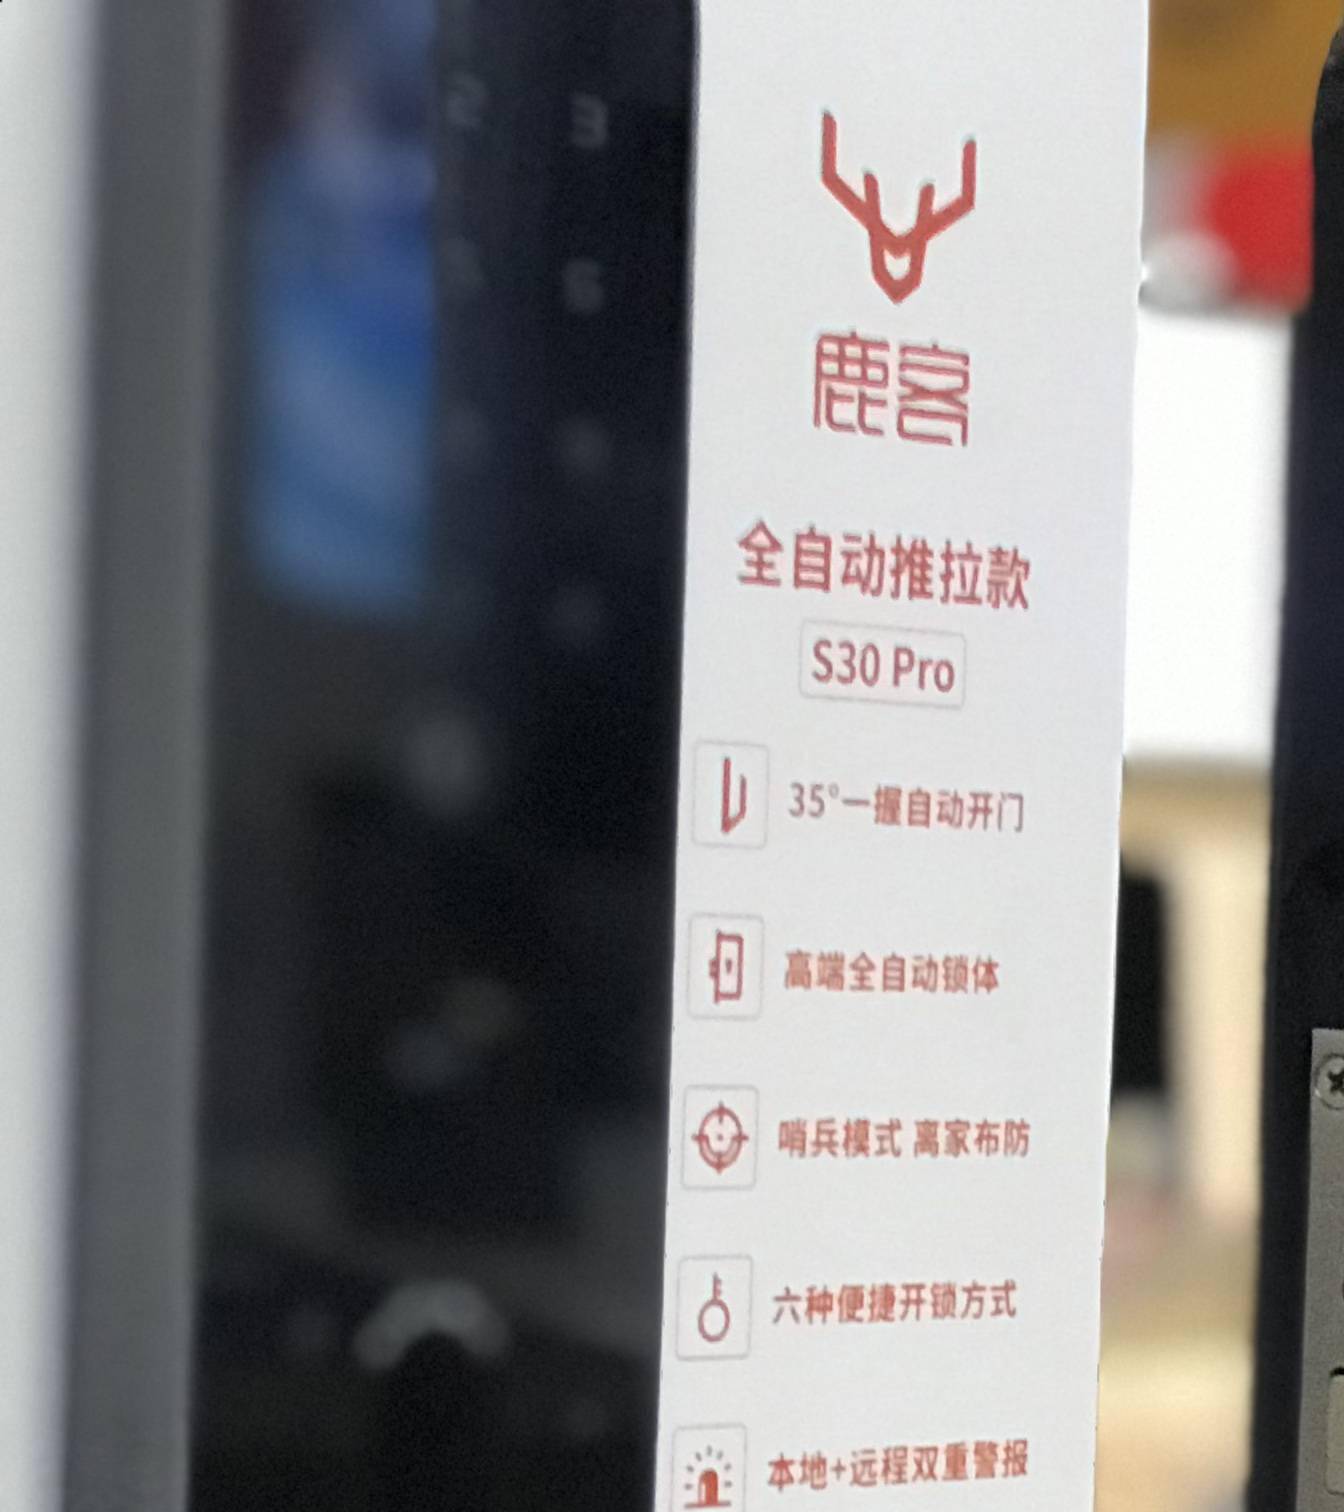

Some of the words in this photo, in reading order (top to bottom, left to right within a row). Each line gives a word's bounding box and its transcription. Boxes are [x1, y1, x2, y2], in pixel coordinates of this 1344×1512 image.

[813, 329, 970, 447] 鹿客
[737, 520, 1031, 611] 全自动推拉款
[812, 639, 881, 687] S30
[893, 648, 956, 693] Pro
[784, 949, 1000, 993] 高端全自动锁体
[778, 1118, 902, 1159] 哨兵模式
[913, 1118, 1030, 1159] 离家布防
[772, 1279, 1018, 1324] 六种便捷开锁方式
[767, 1439, 1029, 1492] 本地+远程双重警报
